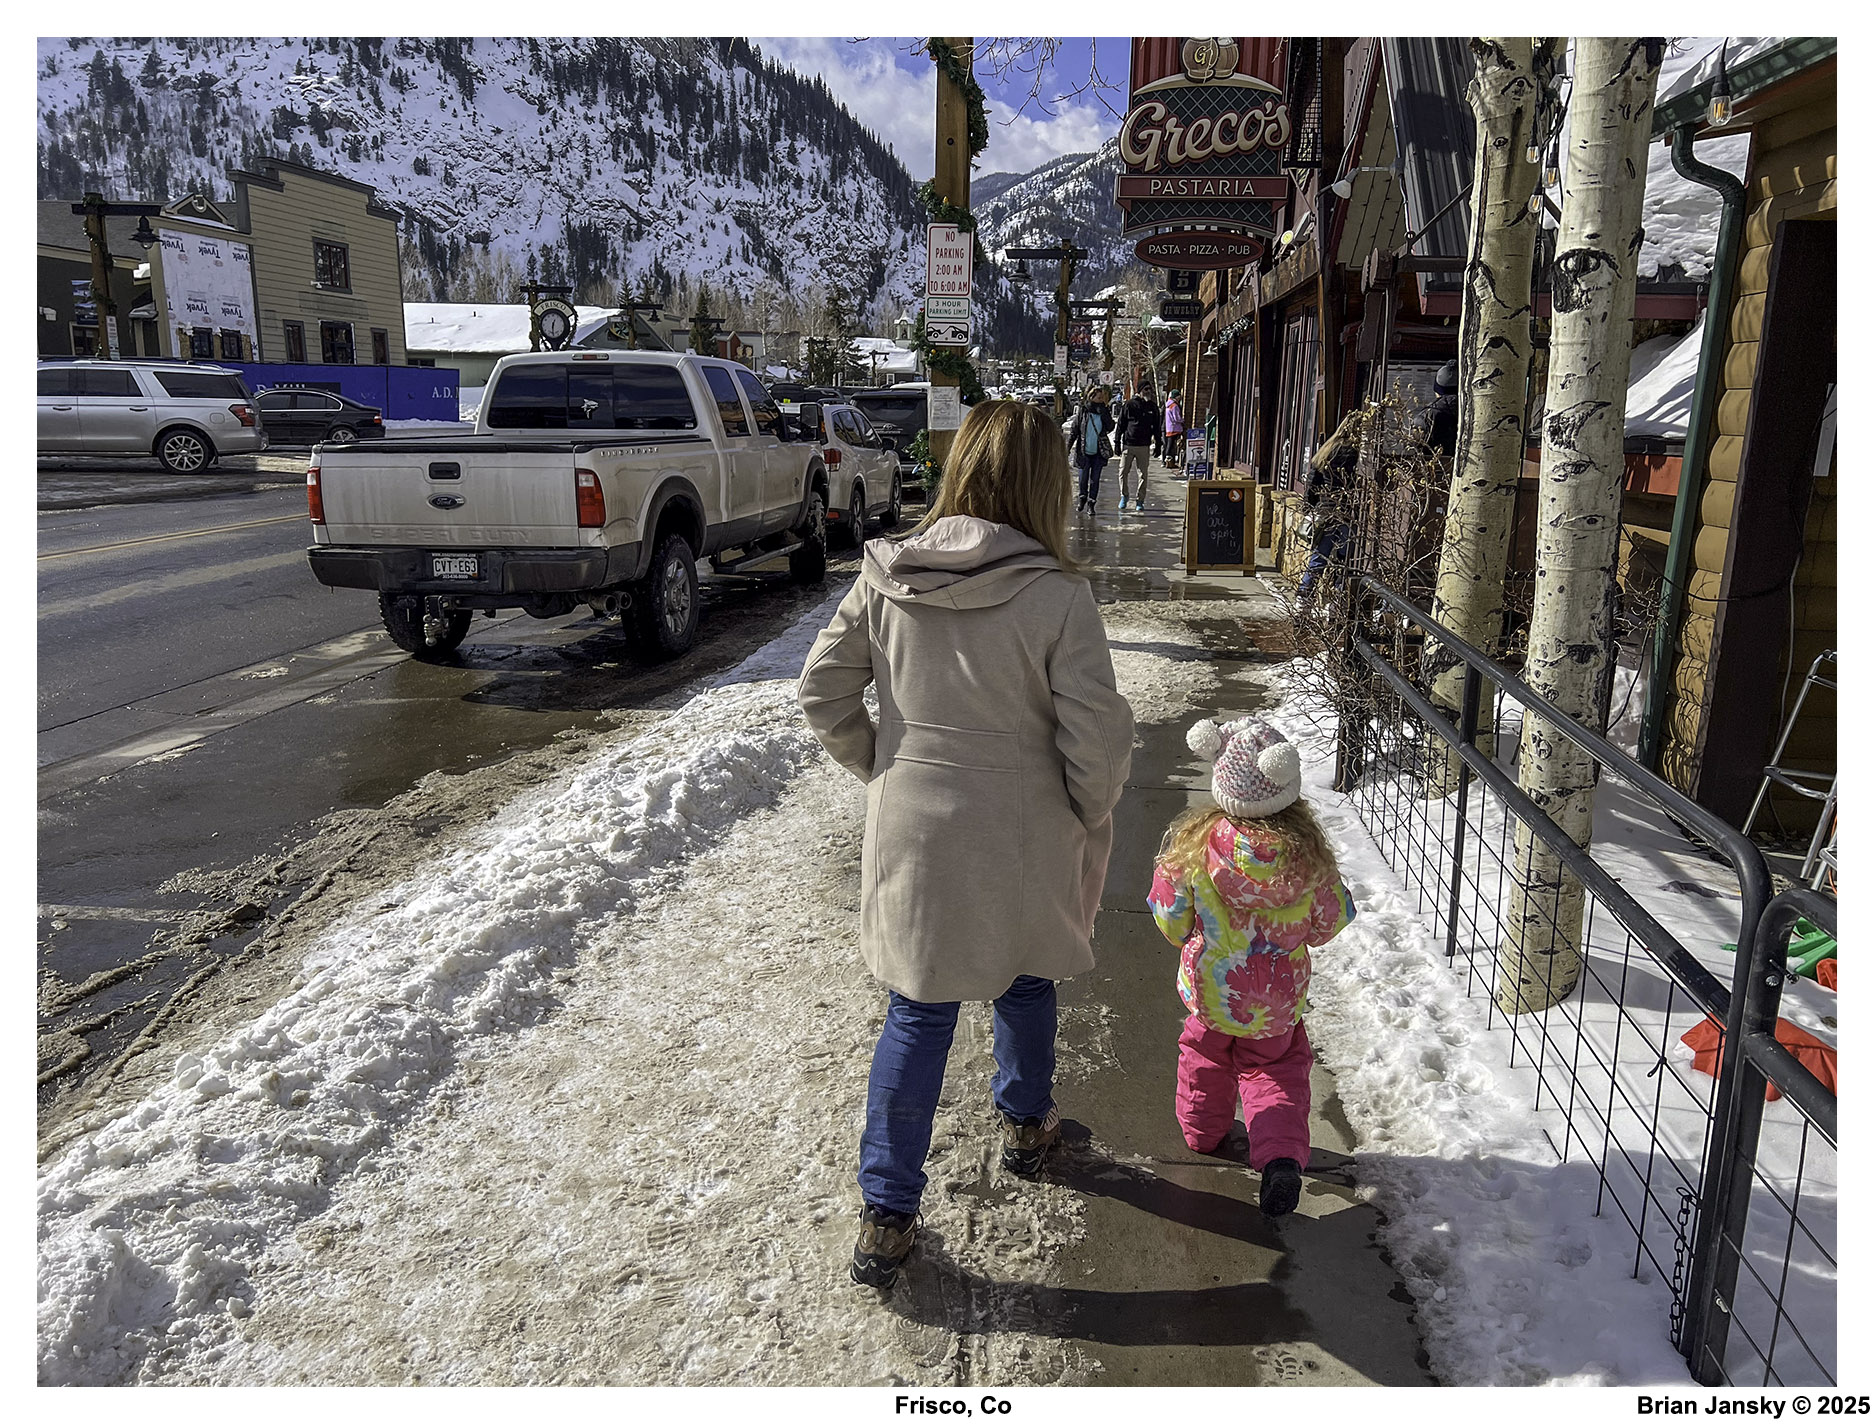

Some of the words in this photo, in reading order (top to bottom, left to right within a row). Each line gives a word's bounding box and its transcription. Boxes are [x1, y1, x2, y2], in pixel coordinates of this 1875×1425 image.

[1121, 100, 1290, 172] Greco's
[1150, 180, 1255, 195] PASTARIA
[945, 231, 955, 242] NO
[162, 240, 185, 252] Tyvek
[1148, 244, 1181, 254] PASTA
[1189, 244, 1219, 255] PIZZA
[1228, 245, 1251, 255] PUB
[198, 247, 221, 259] Tyvek
[935, 248, 964, 258] PARKING
[936, 264, 951, 275] 2:00
[953, 265, 963, 275] AM
[930, 281, 938, 291] TO
[940, 281, 956, 291] 6:00
[958, 282, 968, 292] AM
[186, 302, 209, 314] Tyvek
[541, 301, 566, 310] FRISCO
[1164, 305, 1200, 315] JEWELRY
[221, 307, 243, 318] Tyvek
